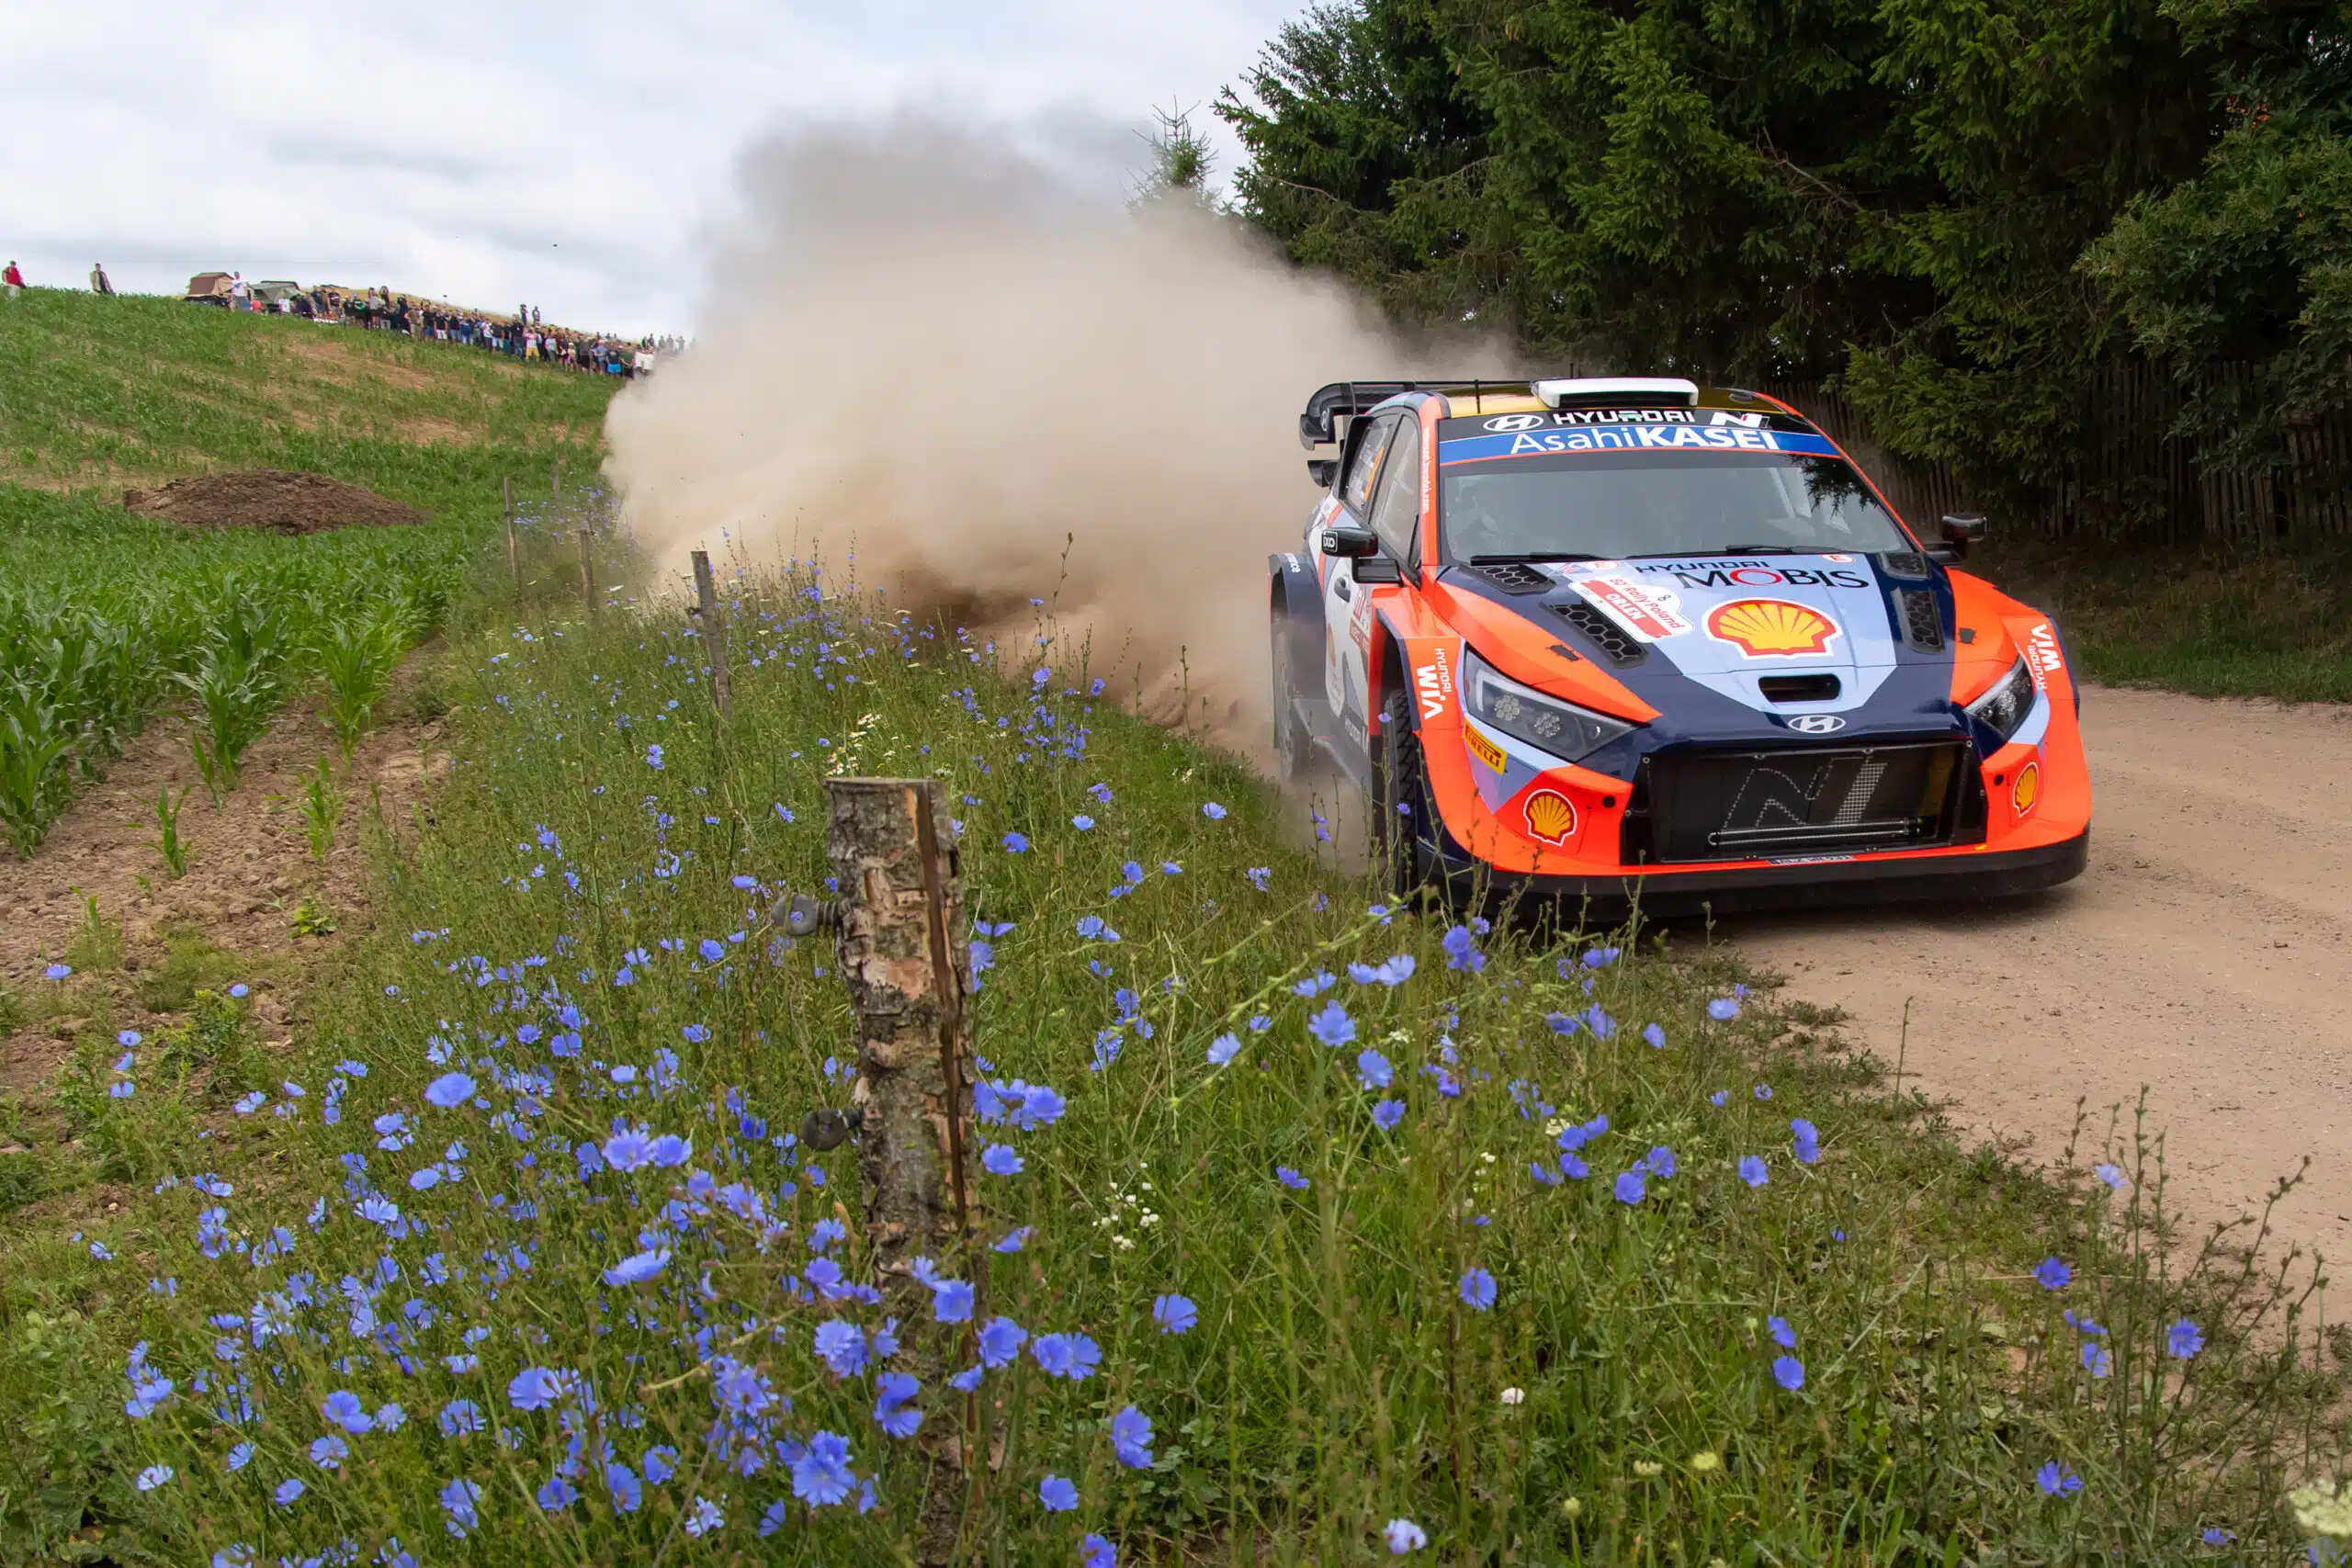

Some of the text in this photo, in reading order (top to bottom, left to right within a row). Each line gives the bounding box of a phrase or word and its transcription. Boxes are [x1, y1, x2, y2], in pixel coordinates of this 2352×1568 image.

[1553, 411, 1695, 424] HYUNDAI
[1635, 560, 1770, 573] HYUNDAI
[1671, 568, 1870, 589] MOBIS
[1605, 592, 1647, 620] ORLEN
[1624, 586, 1654, 604] Rally
[1645, 600, 1685, 629] Poland
[1434, 648, 1453, 693] HYUNDAI
[2027, 645, 2048, 689] HYUNDAI
[1464, 723, 1503, 768] PIRELLI
